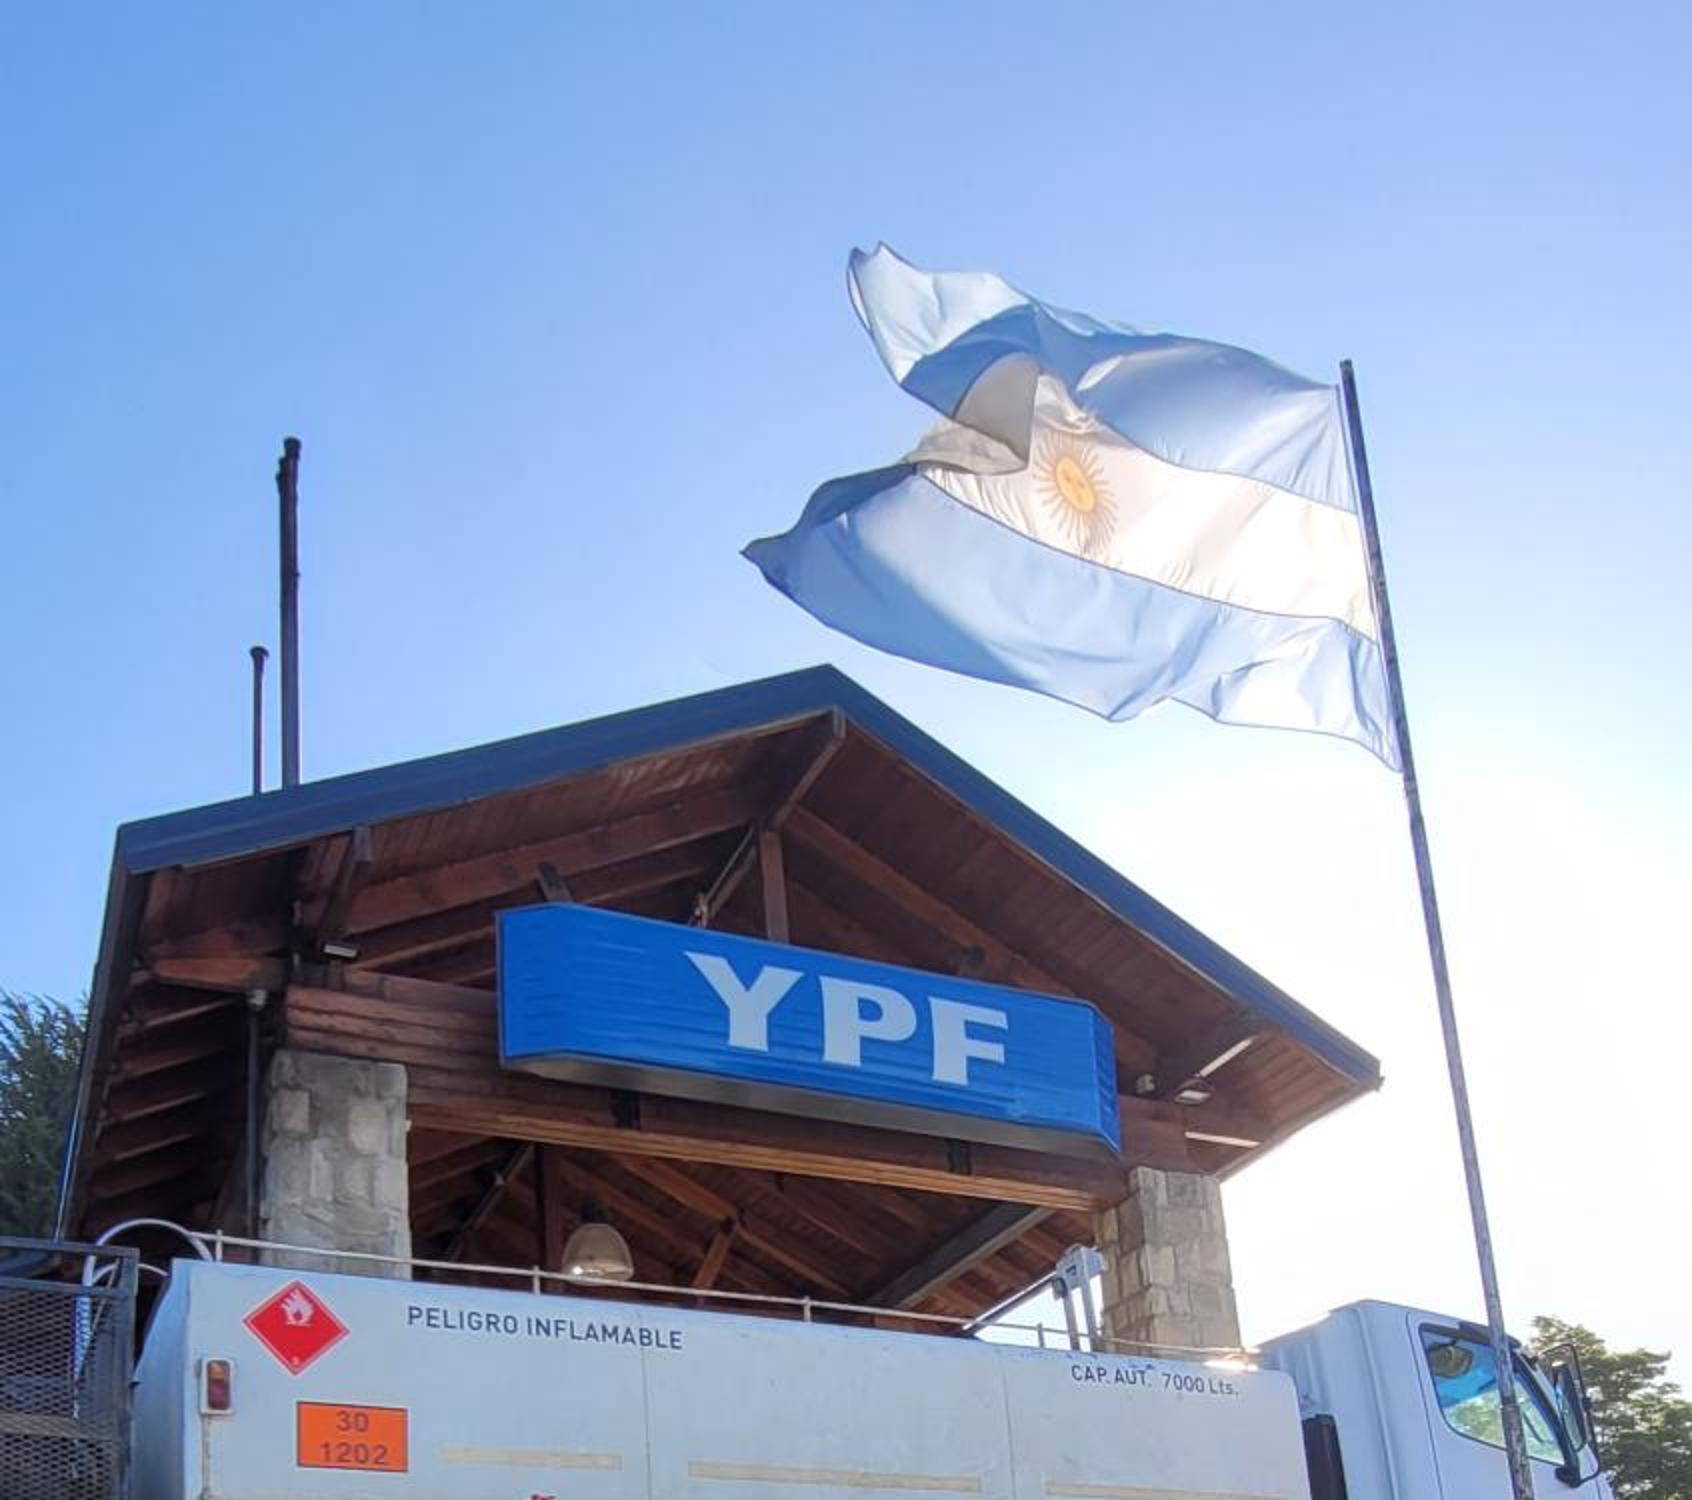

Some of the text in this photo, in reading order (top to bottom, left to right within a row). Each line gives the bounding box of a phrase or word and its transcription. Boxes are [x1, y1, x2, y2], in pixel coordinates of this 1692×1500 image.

[683, 951, 1008, 1086] YPF
[407, 1305, 683, 1350] PELIGRO INFLAMABLE
[1161, 1373, 1205, 1393] 7000
[335, 1410, 369, 1433] 30
[320, 1441, 389, 1466] 1202
